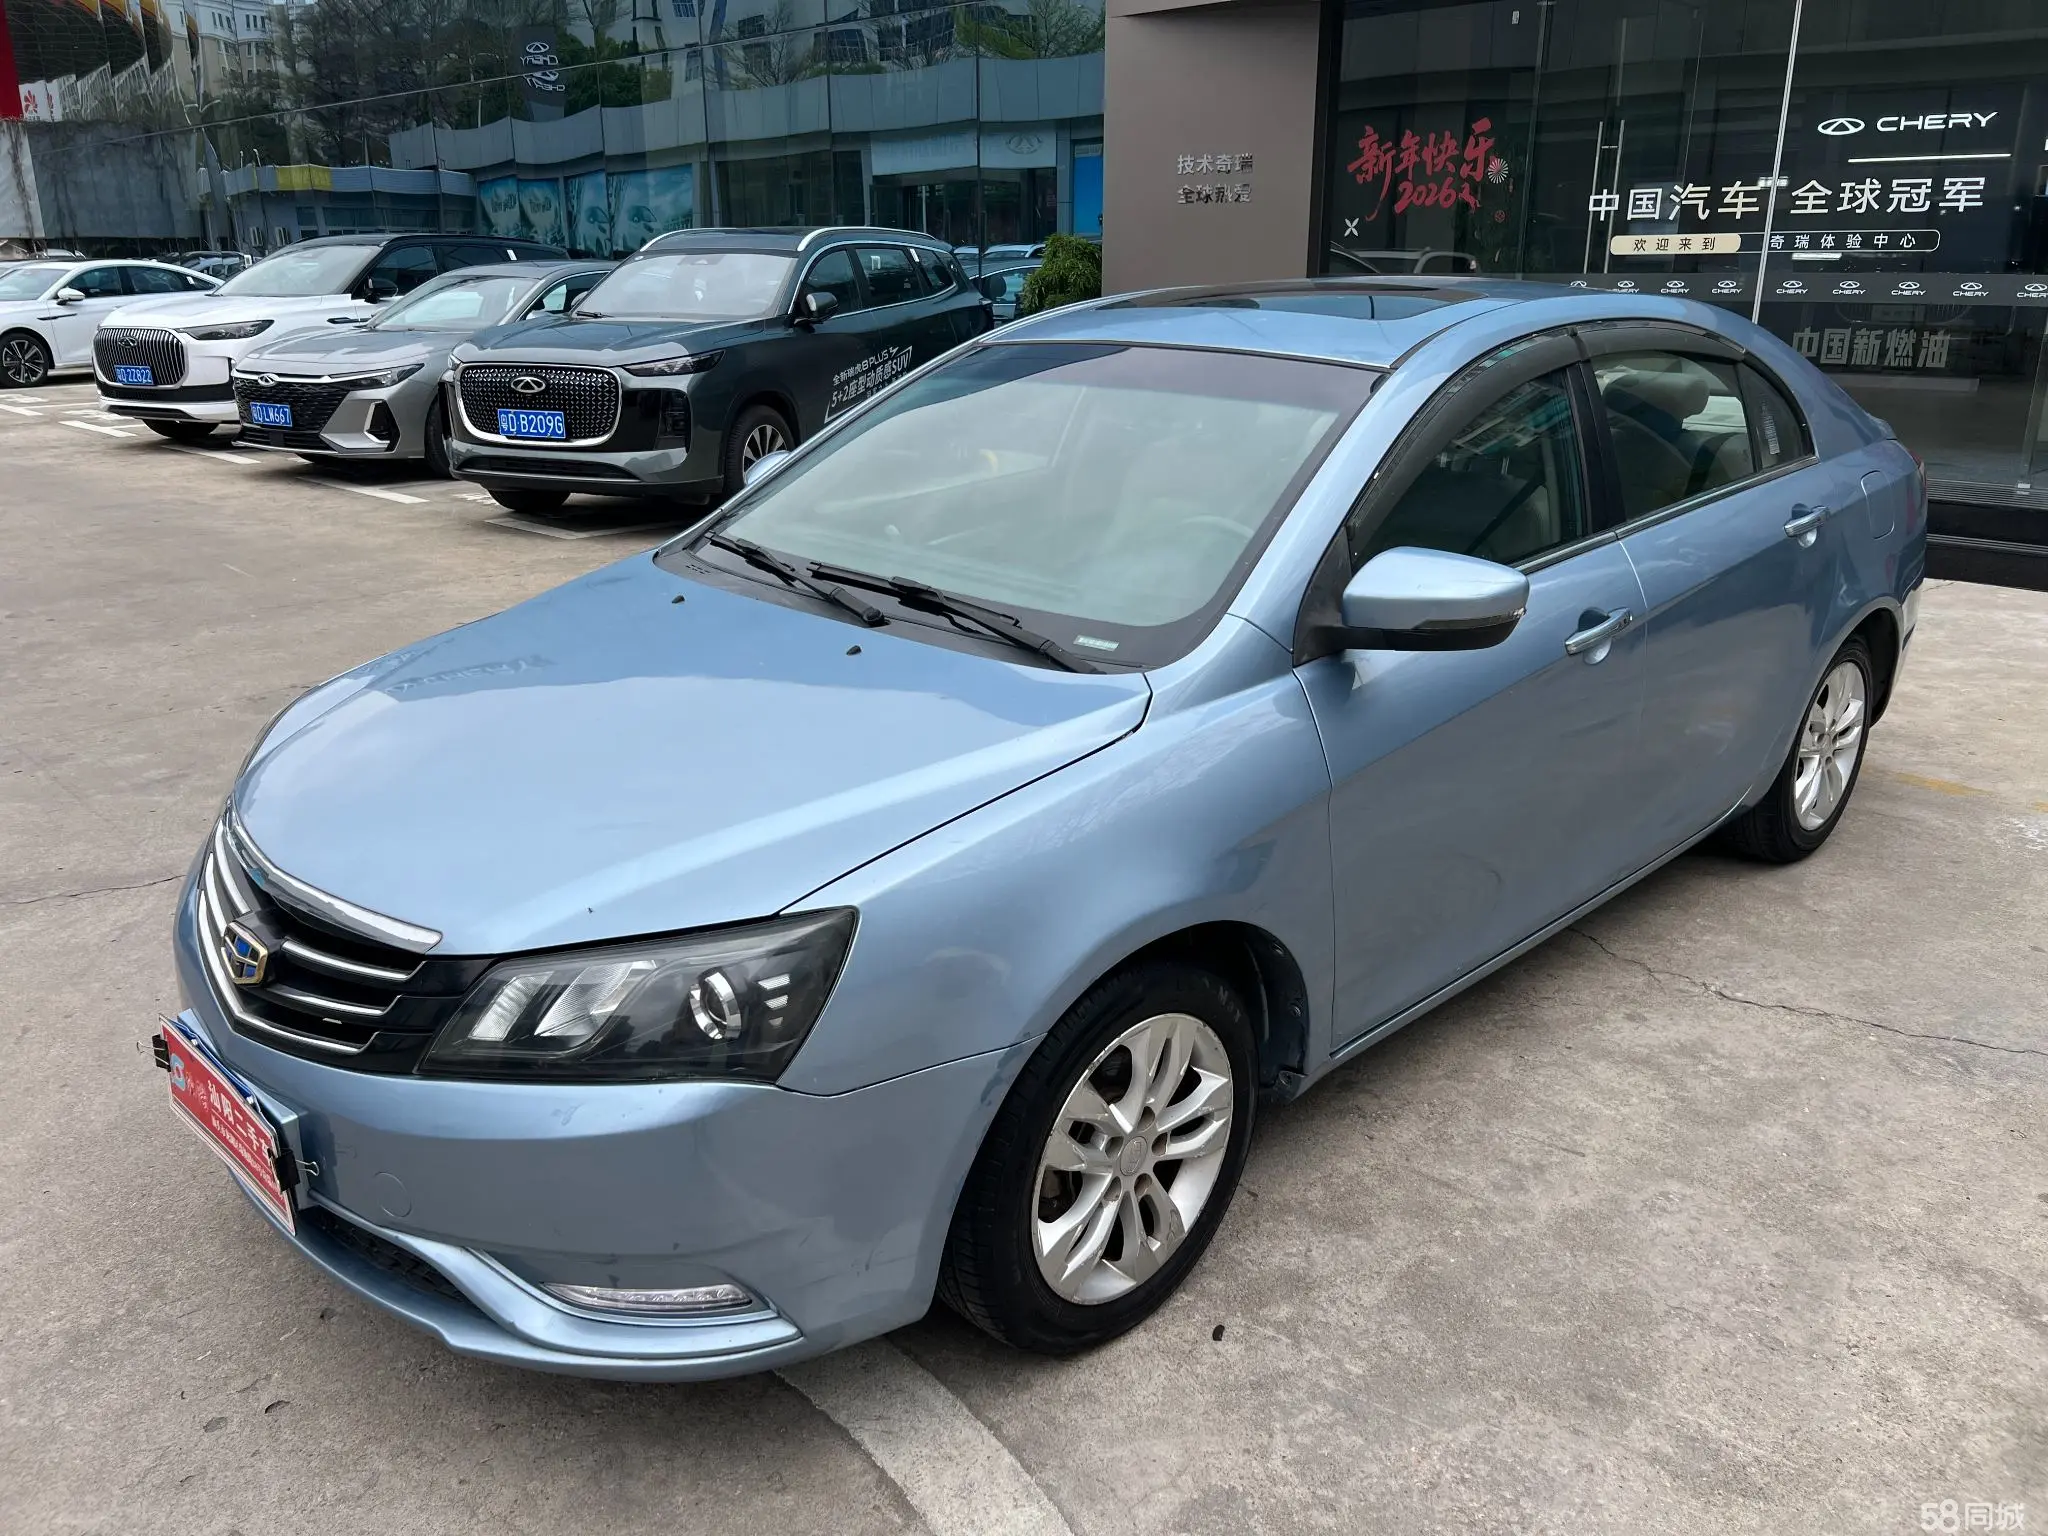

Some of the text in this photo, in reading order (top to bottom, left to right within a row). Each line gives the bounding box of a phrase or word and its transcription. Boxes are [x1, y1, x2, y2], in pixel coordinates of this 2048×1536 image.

[1876, 111, 1999, 132] CHERY
[1177, 153, 1253, 175] 技术奇瑞
[1347, 117, 1498, 221] 新年快乐
[1394, 176, 1457, 214] 2026
[1588, 176, 1987, 221] 中国汽车 全球冠军
[1633, 233, 1917, 251] 欢迎来到 奇瑞体验中心
[1793, 326, 1952, 368] 中国新燃油
